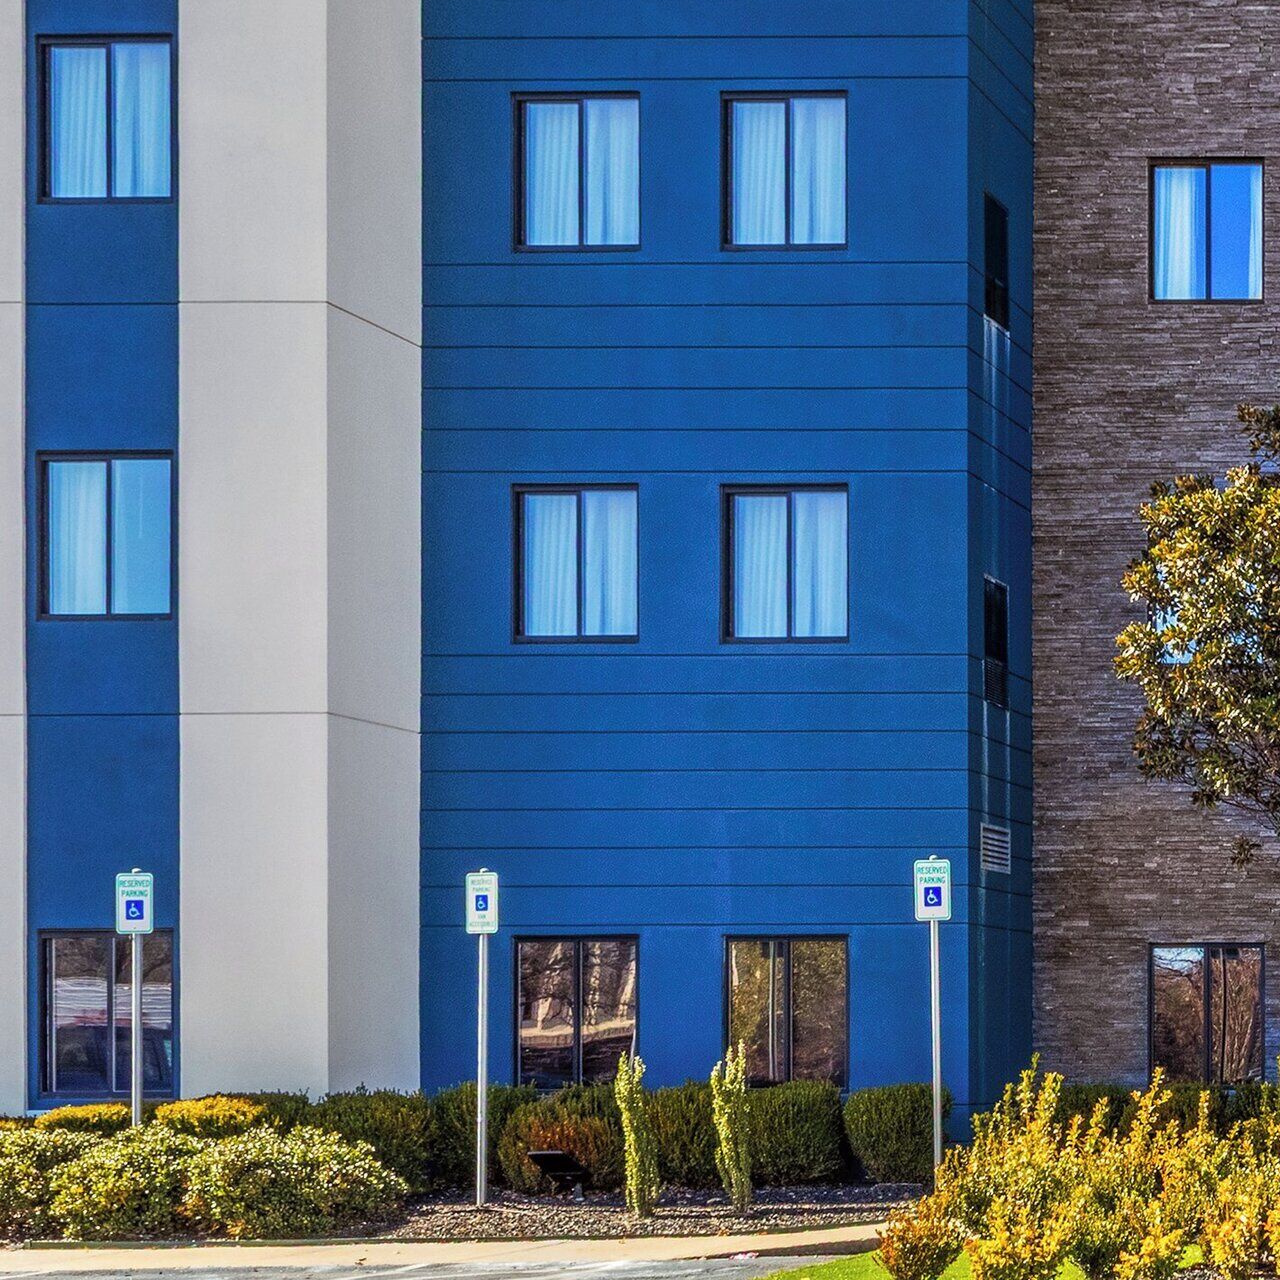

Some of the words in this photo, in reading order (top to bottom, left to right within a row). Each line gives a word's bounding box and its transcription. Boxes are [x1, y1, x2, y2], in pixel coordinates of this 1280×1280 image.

[917, 867, 947, 875] RESERVED
[118, 880, 151, 888] RESERVED
[920, 876, 946, 884] PARKING
[121, 889, 149, 897] PARKING
